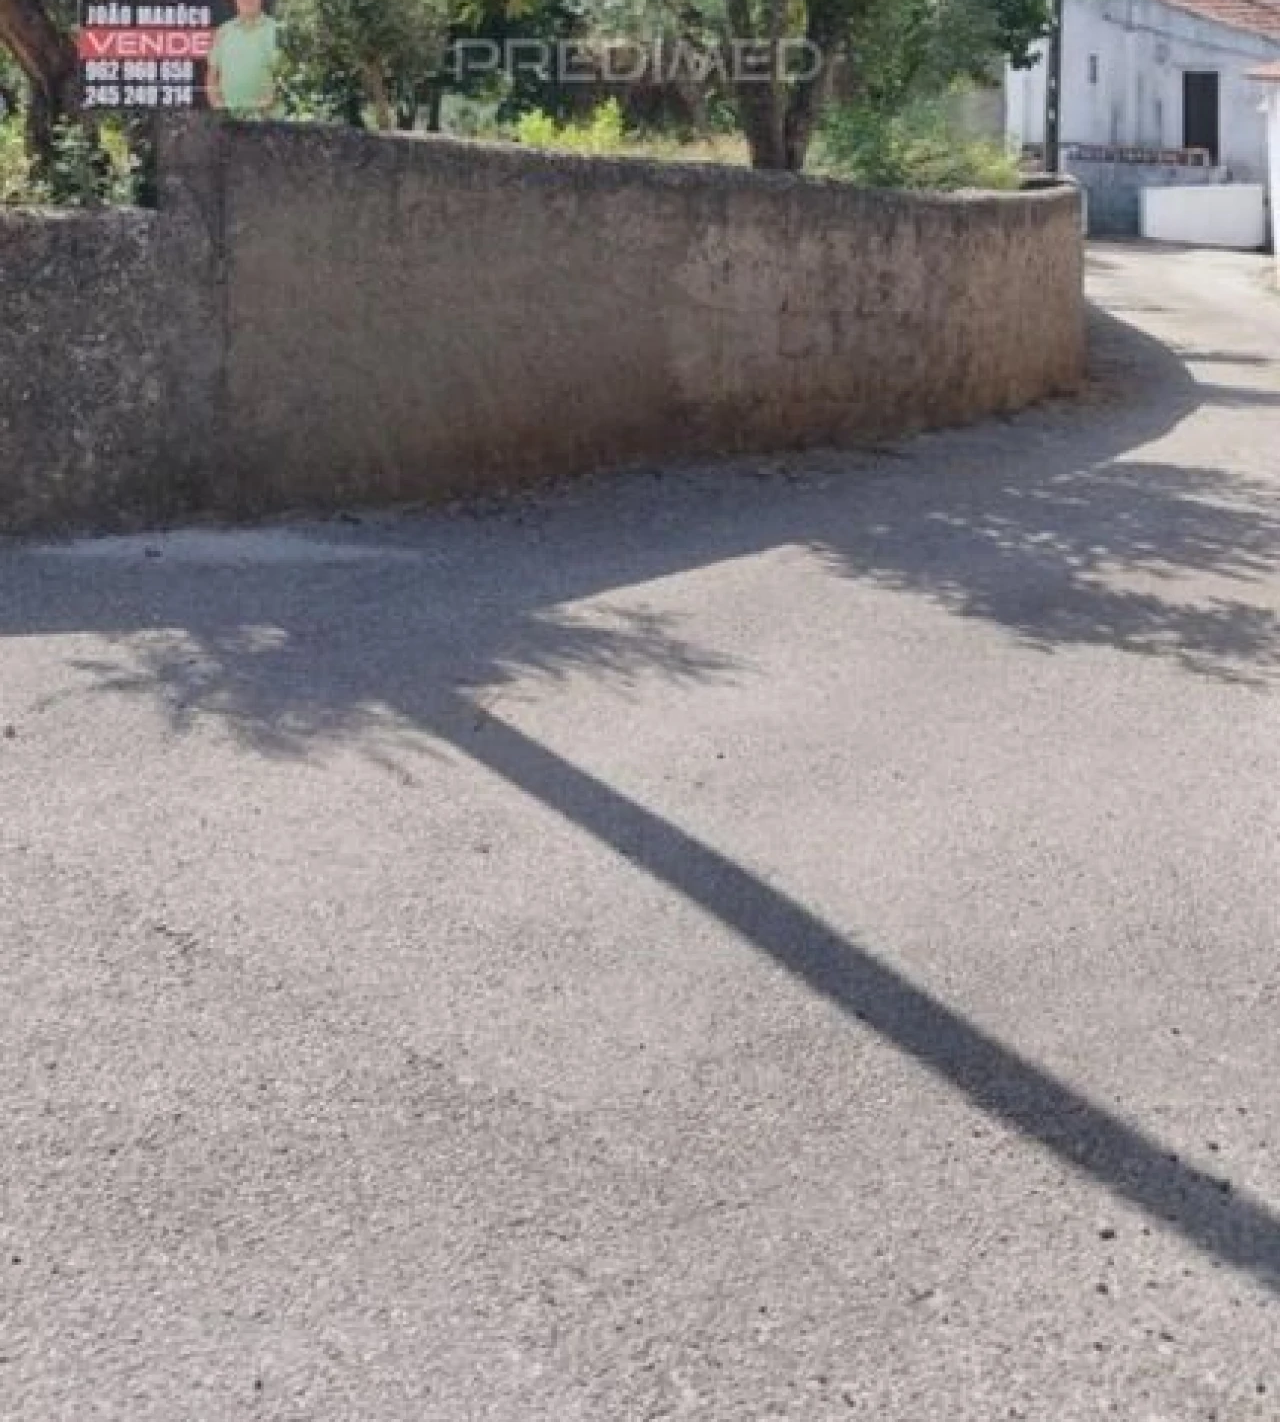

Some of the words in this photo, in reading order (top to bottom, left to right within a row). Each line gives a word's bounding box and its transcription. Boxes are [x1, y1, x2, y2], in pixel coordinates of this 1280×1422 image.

[87, 3, 131, 25] JOÃO
[85, 32, 211, 54] VENDE
[85, 85, 119, 105] 245
[161, 85, 193, 105] 314
